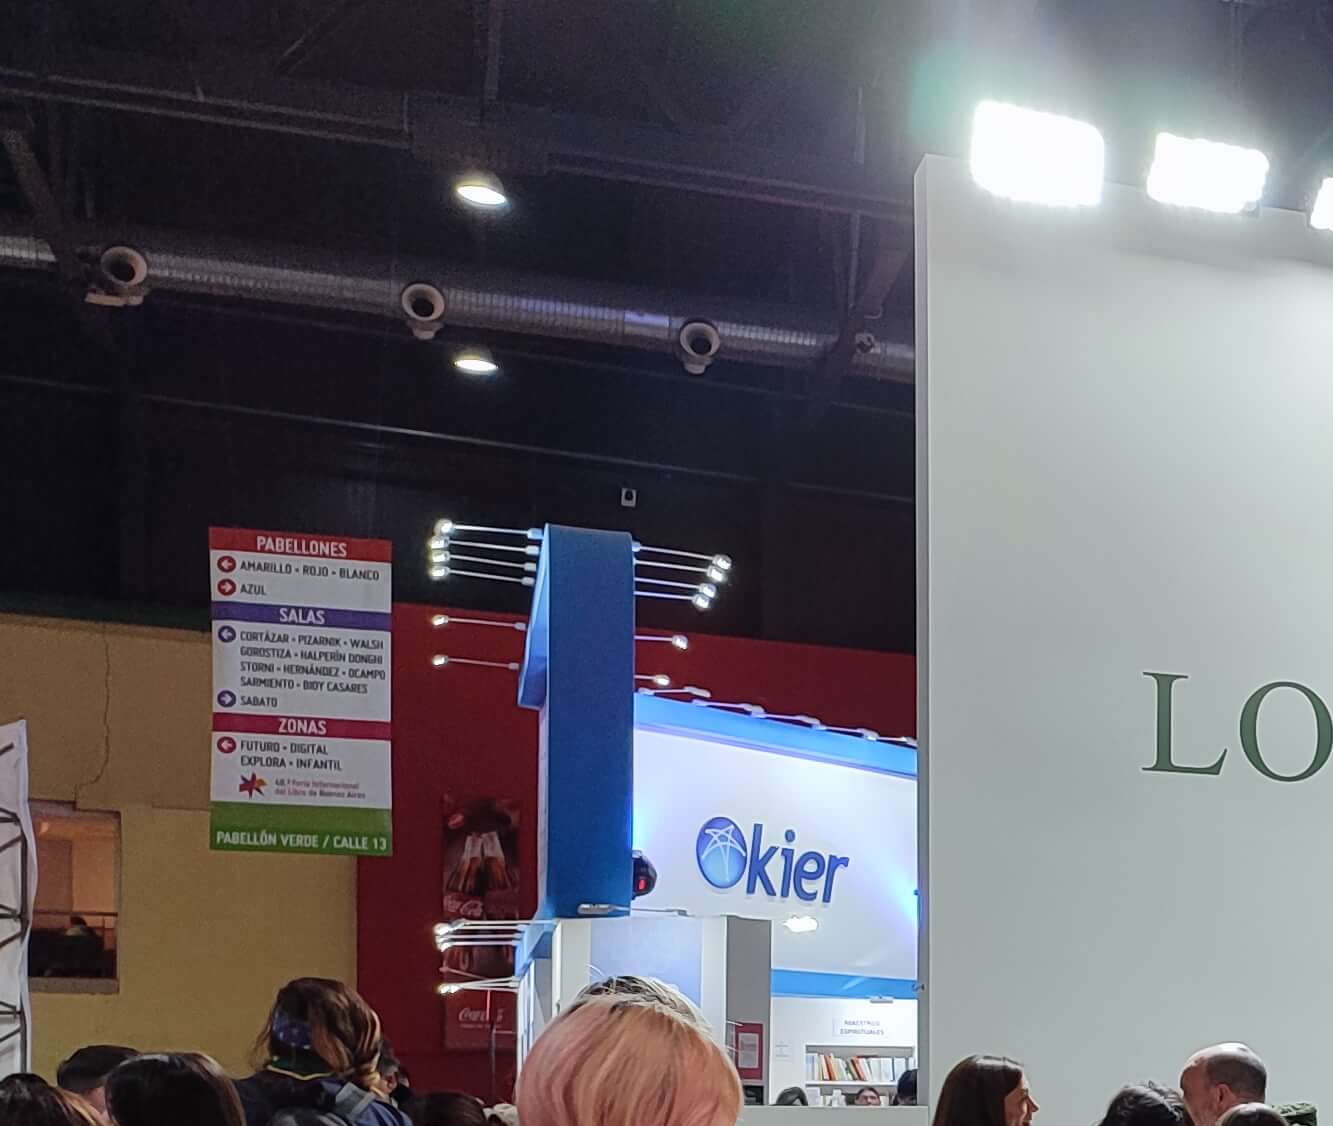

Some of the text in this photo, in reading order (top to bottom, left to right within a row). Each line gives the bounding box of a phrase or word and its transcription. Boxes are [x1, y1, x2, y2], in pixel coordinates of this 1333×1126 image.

[256, 536, 347, 557] PABELLONES
[240, 561, 380, 581] AMARILLO ROJO BLANCO
[240, 584, 267, 595] AZUL
[279, 607, 325, 624] SALAS
[240, 629, 384, 650] CORTÁZAR PIZARNIK WALSH
[240, 647, 291, 659] GOROSTIZA
[348, 654, 383, 665] DONGHI
[240, 661, 386, 680] STORNI HERNÁNDEZ OCAMPO
[240, 676, 368, 694] SARMIENTO BIOY CASARES
[240, 696, 278, 707] SABATO
[278, 718, 327, 735] ZONAS
[240, 740, 329, 755] FUTURO DIGITAL
[240, 756, 342, 771] EXPLORA INFANTIL
[216, 829, 277, 846] PABELLÓN
[280, 834, 319, 848] VERDE
[333, 836, 368, 850] CALLE
[372, 837, 387, 851] 13
